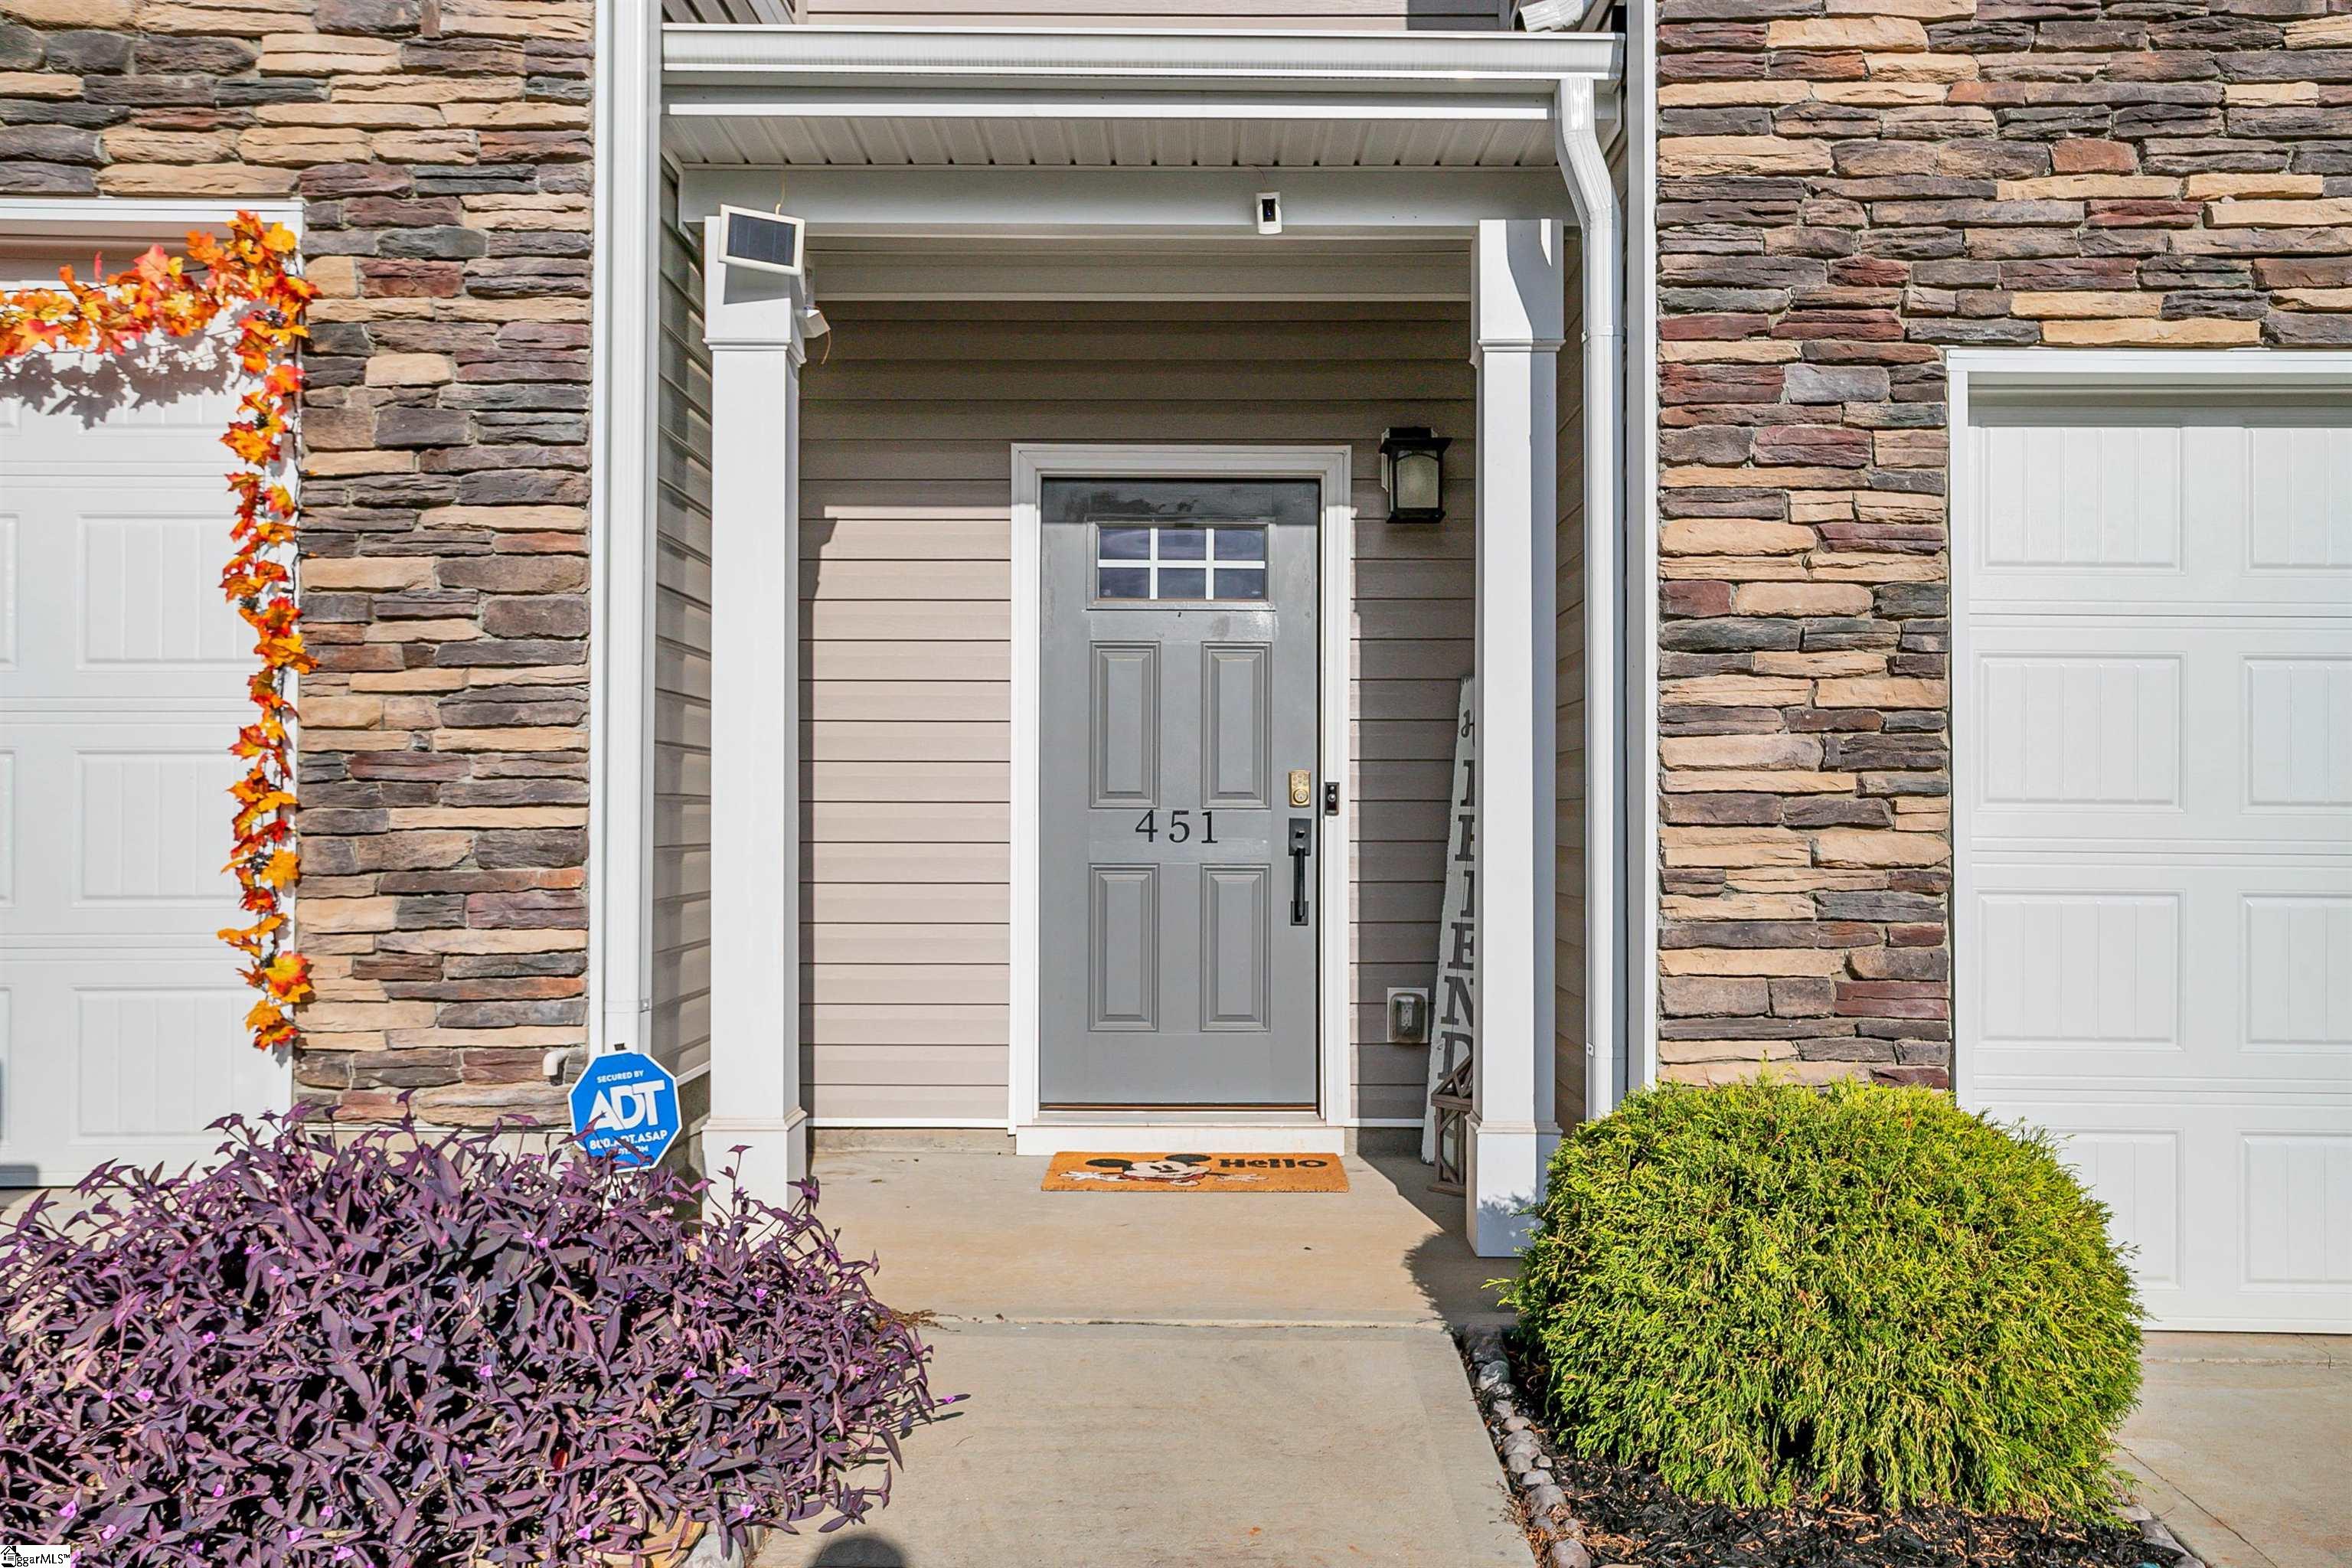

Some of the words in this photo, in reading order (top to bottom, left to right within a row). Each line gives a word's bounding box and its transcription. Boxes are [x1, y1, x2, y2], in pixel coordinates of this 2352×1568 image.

[1135, 809, 1218, 843] 451
[596, 1071, 632, 1083] SECURED
[634, 1070, 644, 1078] BY
[587, 1080, 665, 1131] ADT
[1219, 1158, 1328, 1168] Hello
